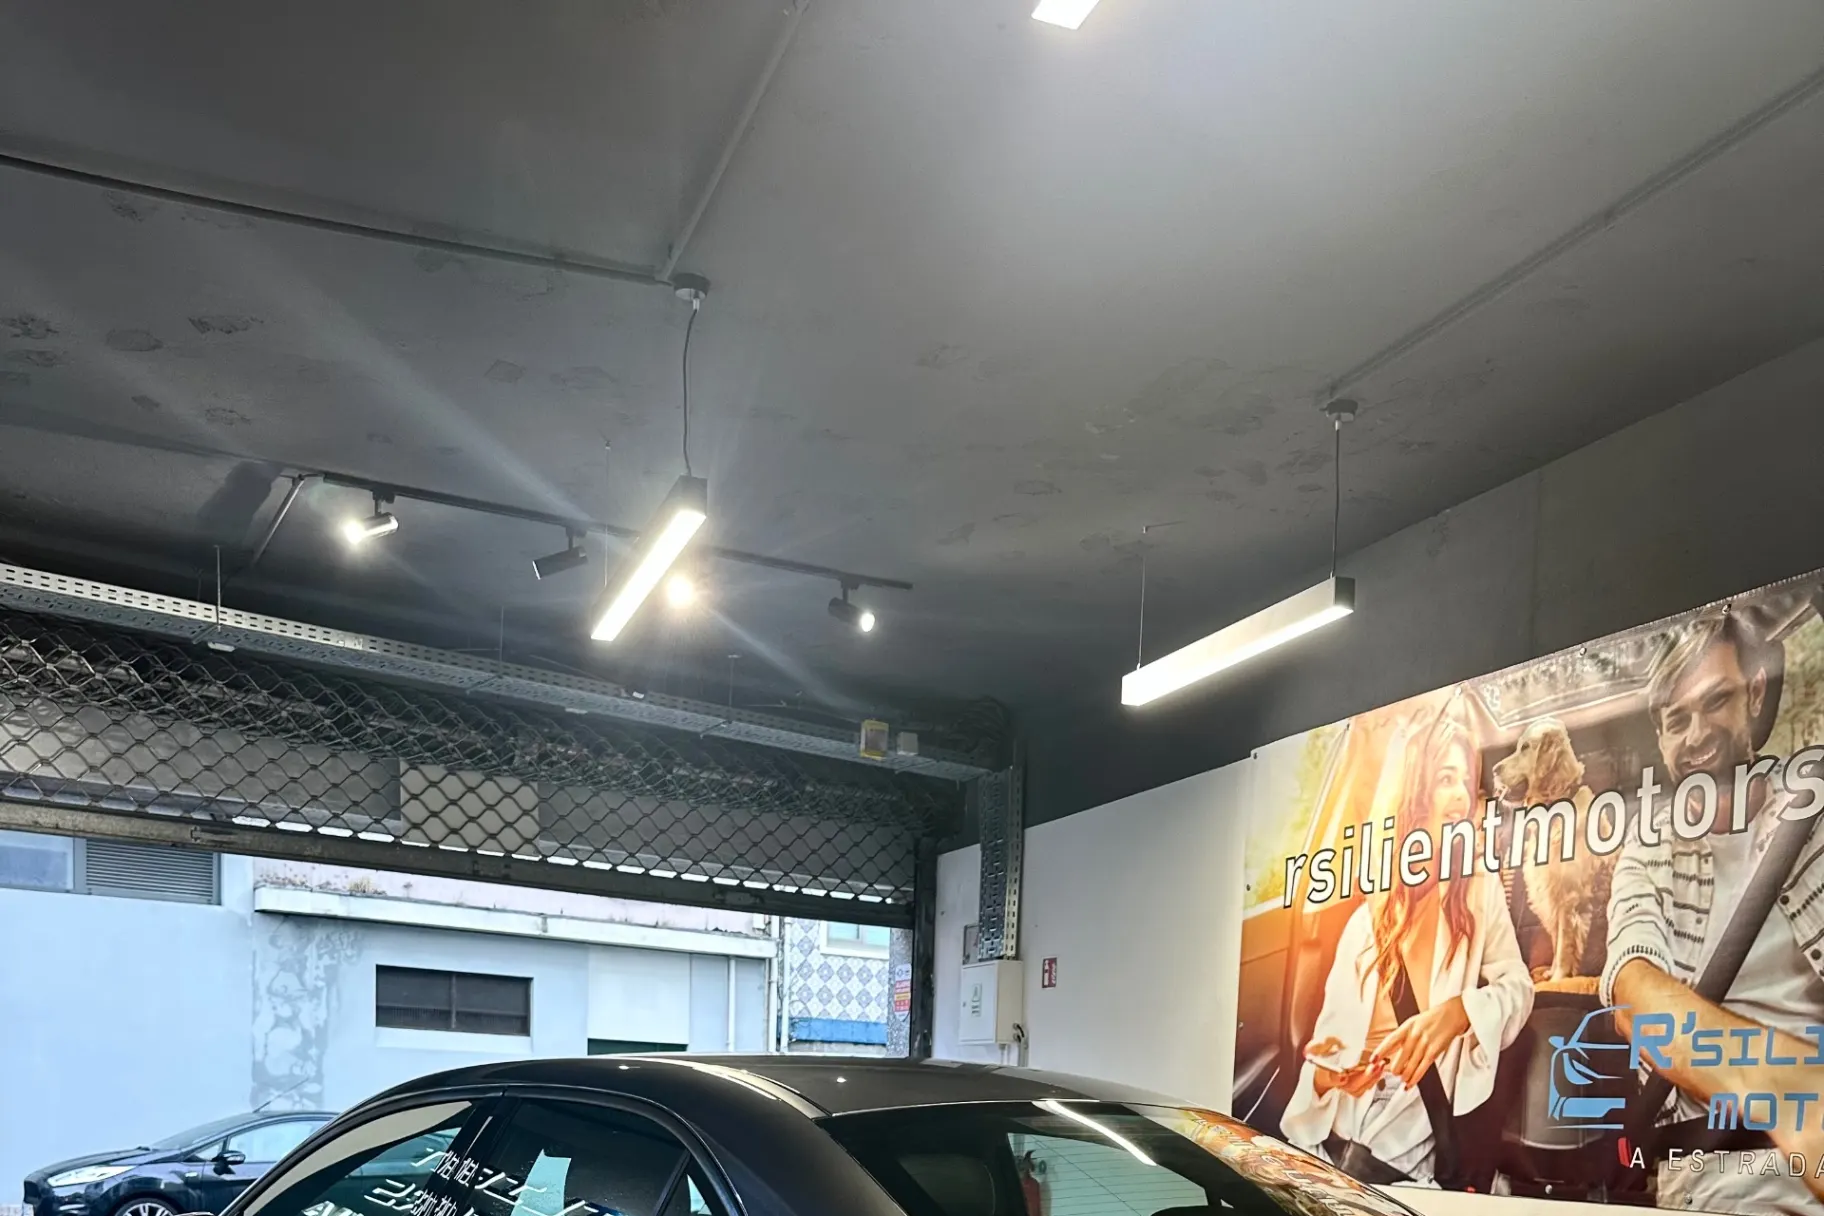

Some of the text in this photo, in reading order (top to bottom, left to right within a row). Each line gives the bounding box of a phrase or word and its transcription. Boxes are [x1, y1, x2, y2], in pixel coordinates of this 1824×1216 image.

[1283, 744, 1824, 909] rsilientmotors
[1707, 1092, 1824, 1131] MOT
[1629, 1147, 1645, 1169] A
